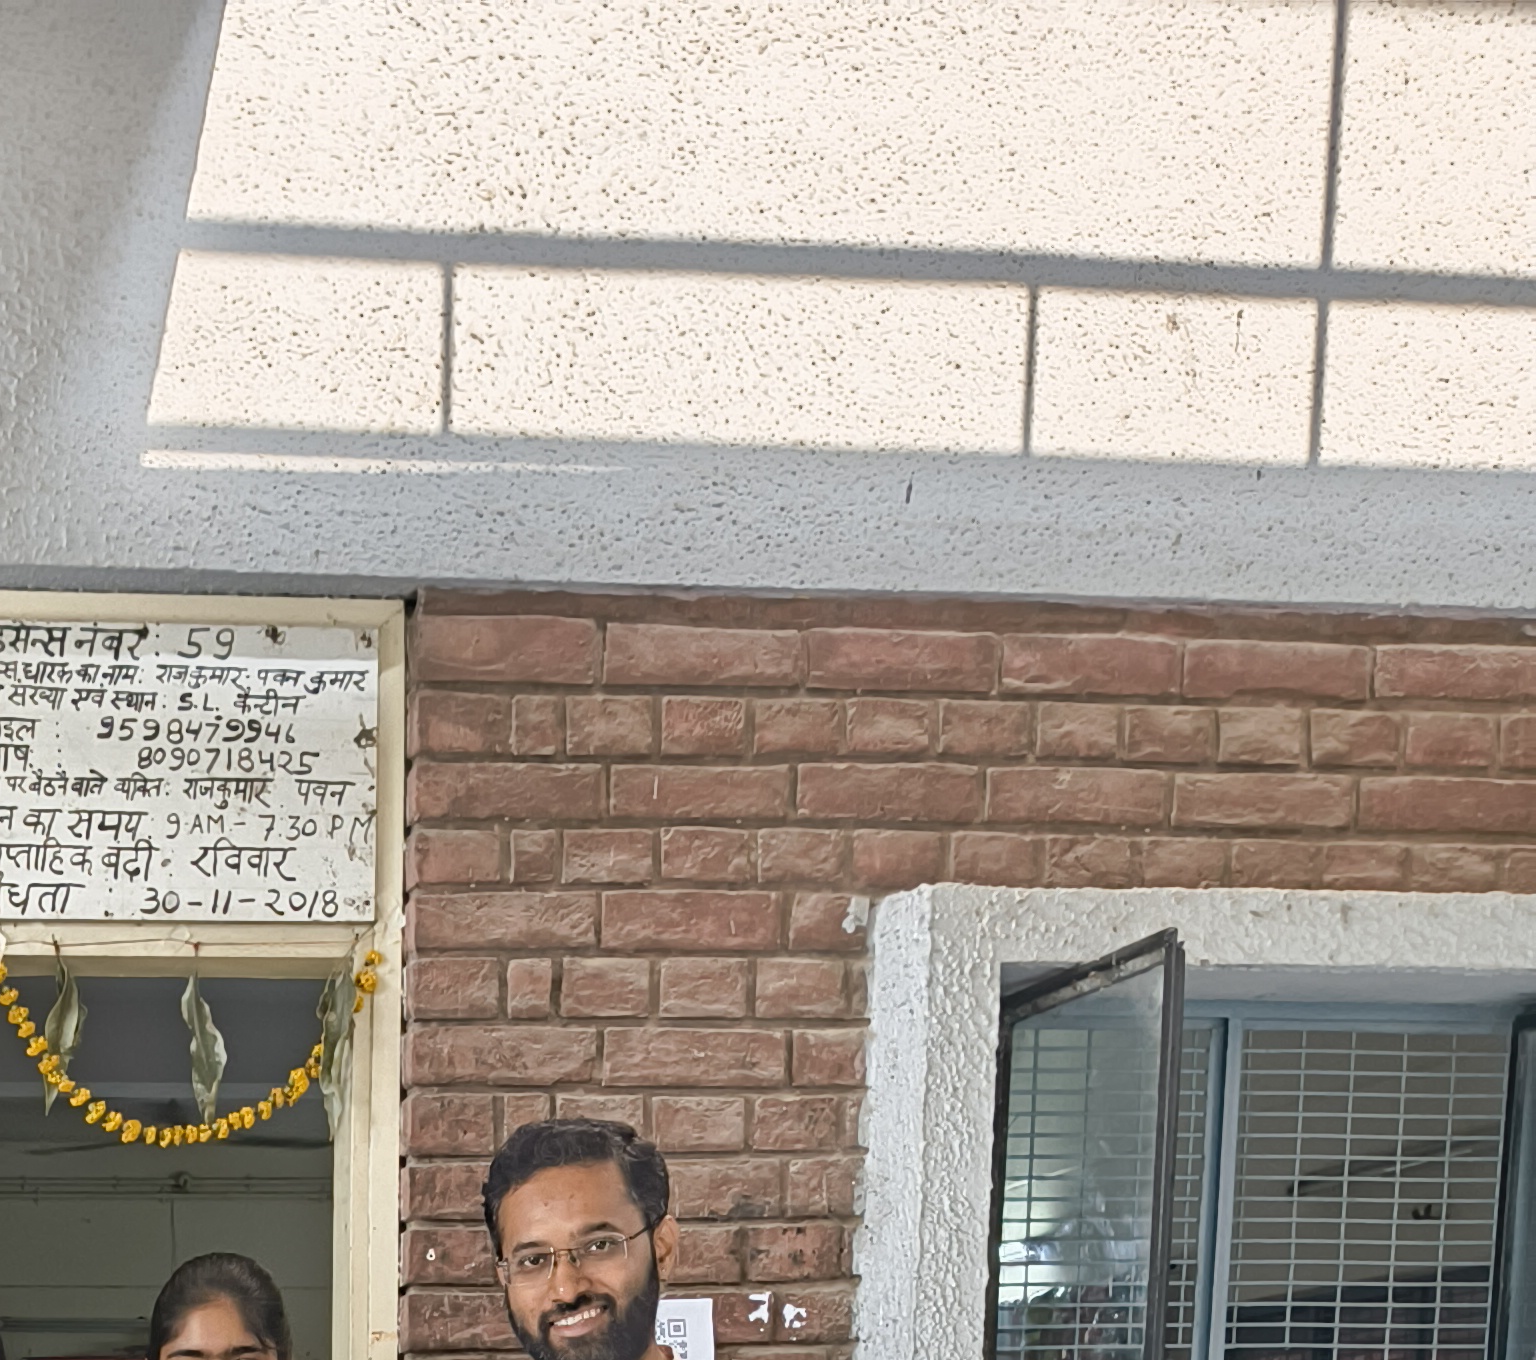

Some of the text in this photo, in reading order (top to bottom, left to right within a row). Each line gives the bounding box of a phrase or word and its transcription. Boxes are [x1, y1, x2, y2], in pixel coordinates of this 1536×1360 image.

[177, 627, 235, 660] 59
[137, 747, 320, 775] 8090718425
[23, 809, 63, 839] का
[190, 837, 297, 881] रविवार
